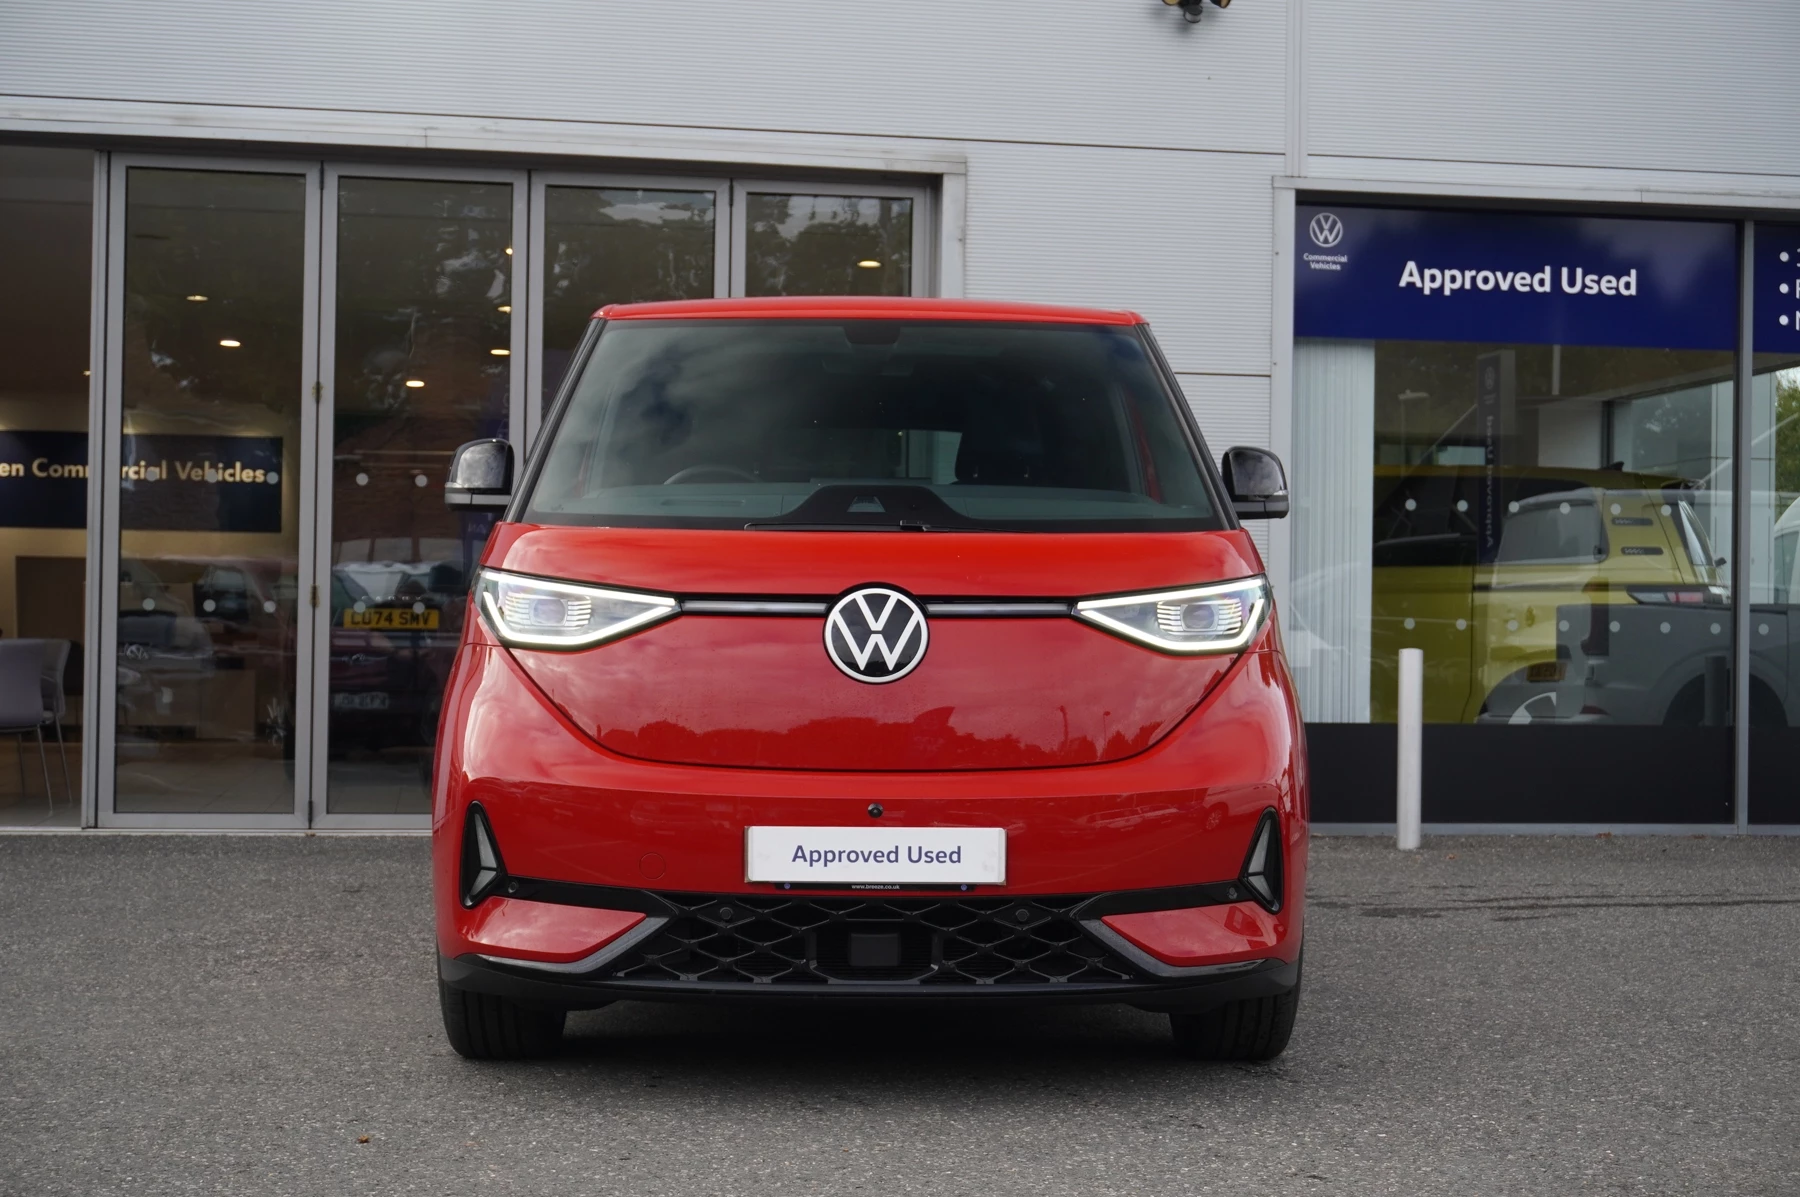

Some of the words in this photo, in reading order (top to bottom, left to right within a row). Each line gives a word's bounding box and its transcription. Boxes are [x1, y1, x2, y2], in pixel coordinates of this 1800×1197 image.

[1303, 253, 1347, 262] Commercial
[1310, 261, 1341, 270] Vehicles
[1399, 260, 1551, 296] Approved
[1561, 266, 1637, 296] Used
[792, 845, 899, 867] Approved
[907, 846, 962, 864] Used
